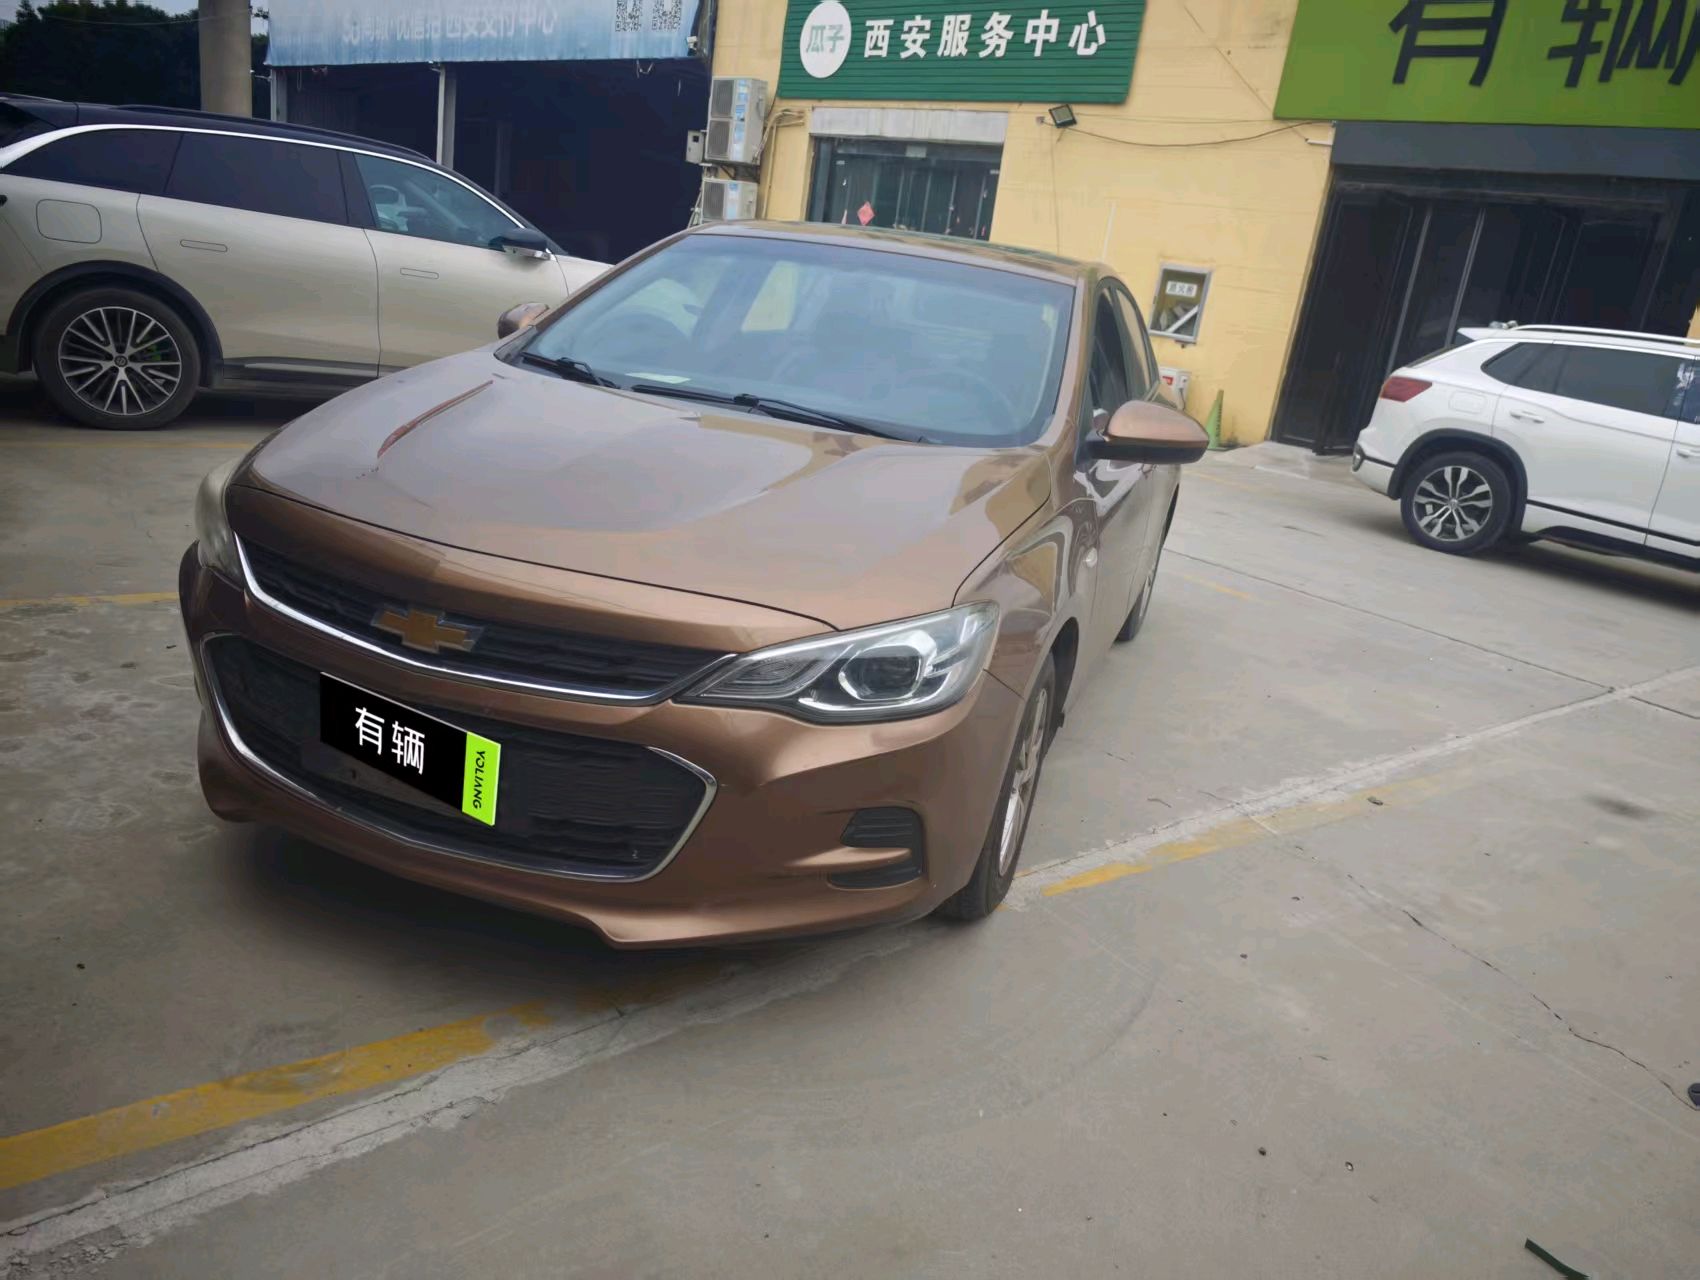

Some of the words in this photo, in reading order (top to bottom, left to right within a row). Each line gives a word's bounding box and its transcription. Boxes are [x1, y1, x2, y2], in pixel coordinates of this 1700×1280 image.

[805, 23, 845, 54] 瓜子
[863, 9, 1107, 59] 西安服务中心
